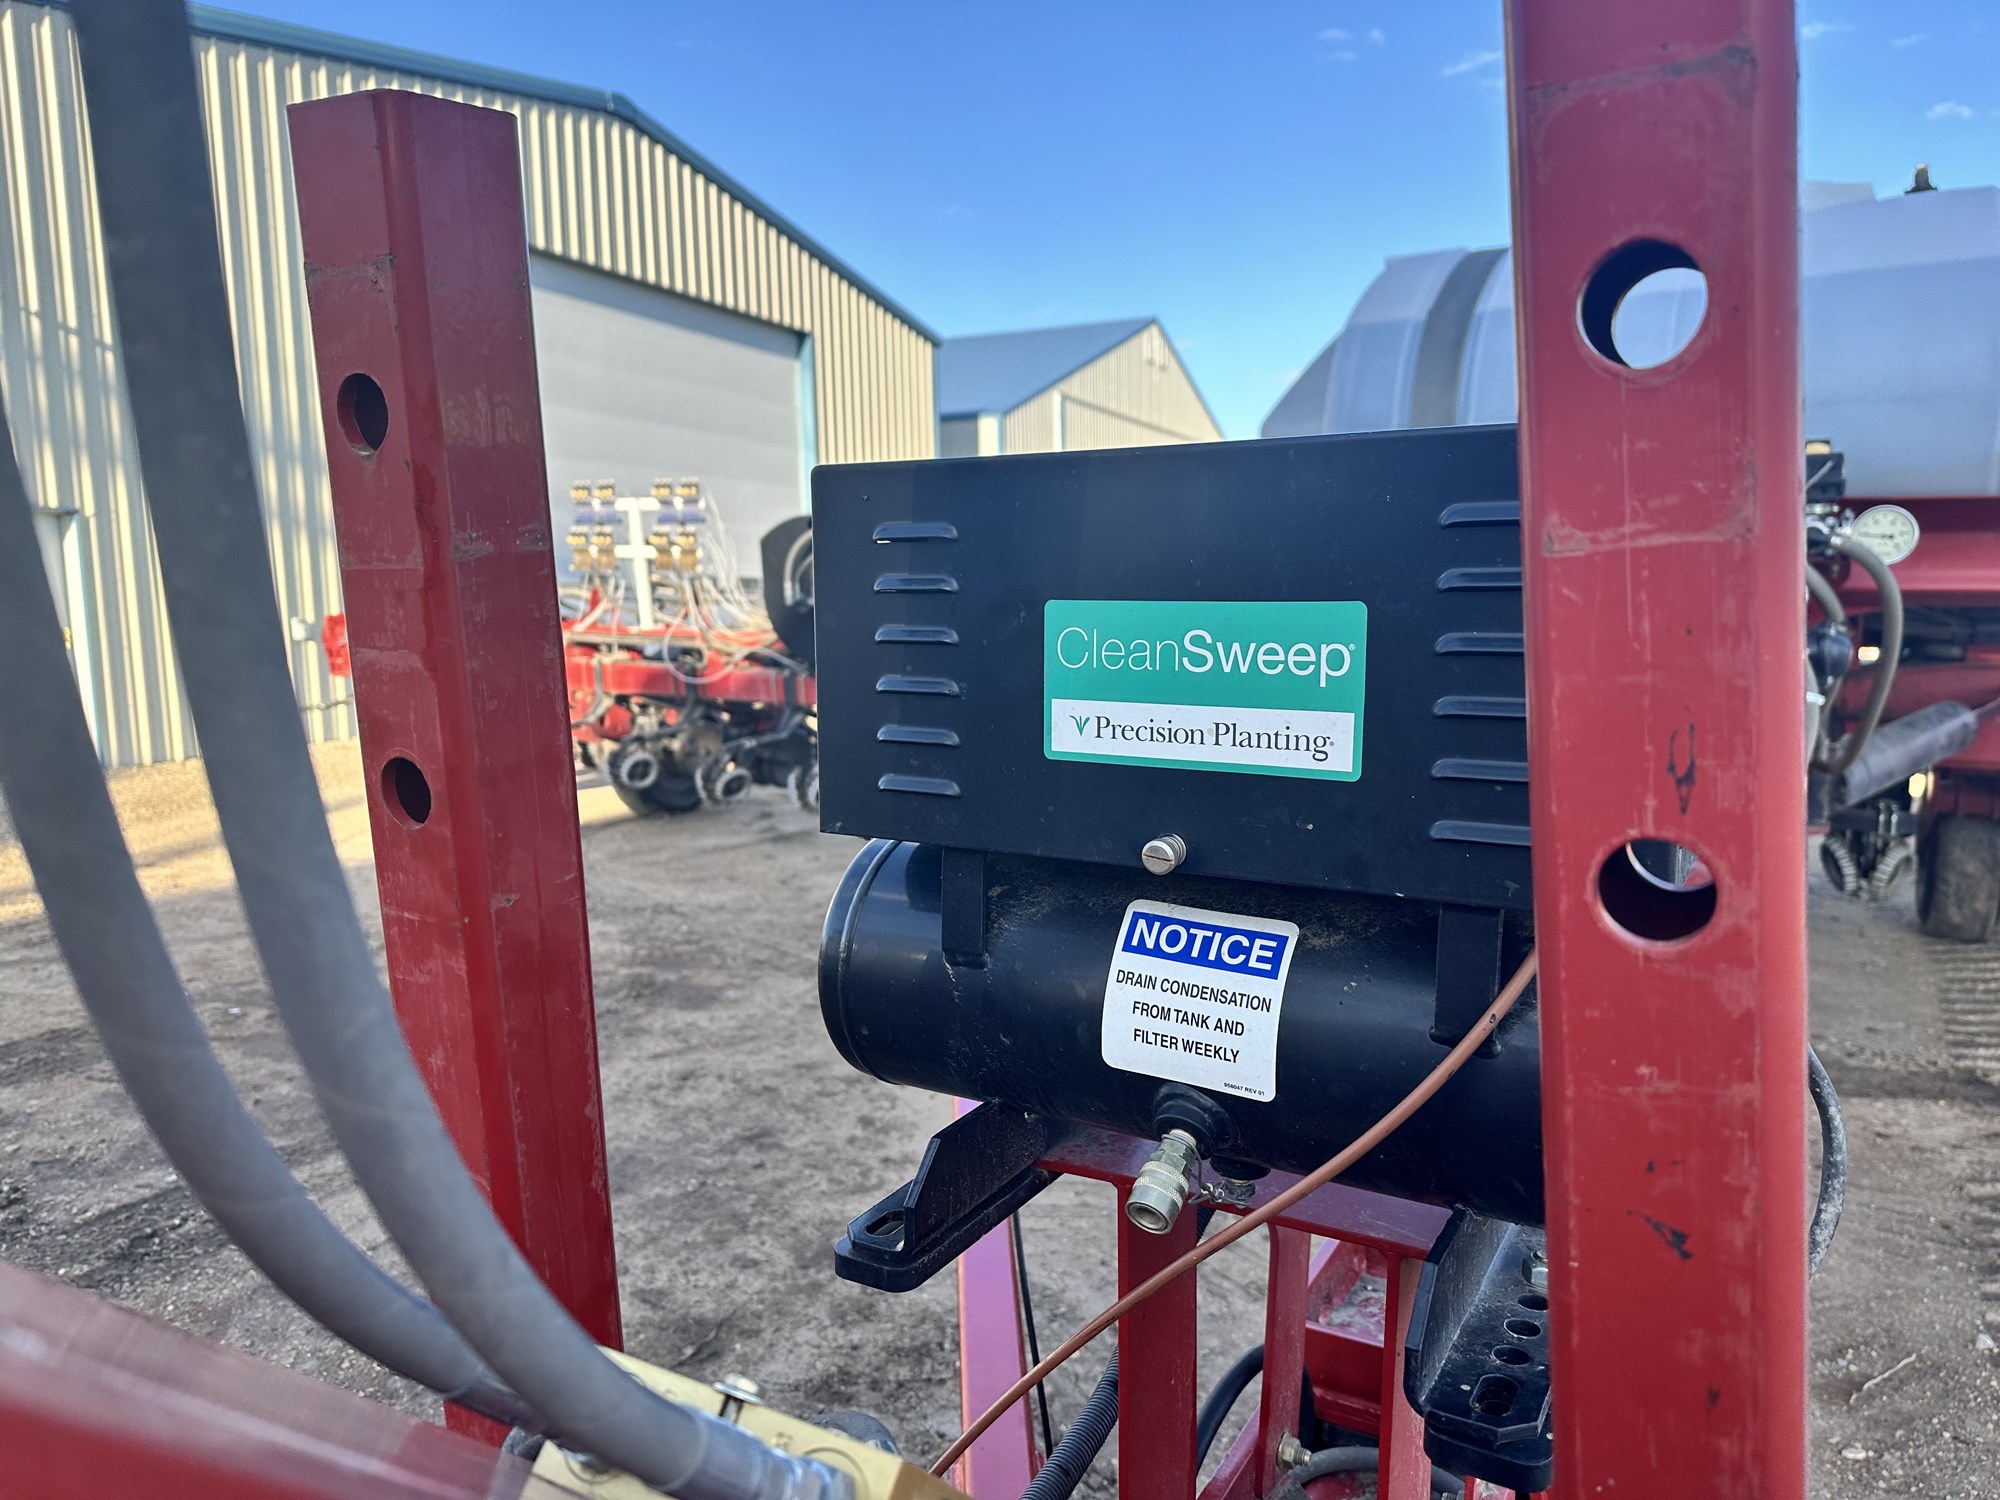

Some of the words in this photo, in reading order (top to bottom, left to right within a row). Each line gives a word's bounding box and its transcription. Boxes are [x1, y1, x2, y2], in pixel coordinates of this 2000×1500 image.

[1094, 715, 1206, 746] Precision
[1131, 918, 1278, 971] NOTICE
[1116, 969, 1158, 990] DRAIN
[1160, 978, 1272, 1013] CONDENSATION
[1132, 1001, 1171, 1022] FROM
[1174, 1009, 1211, 1030] TANK
[1214, 1018, 1245, 1037] AND
[1133, 1028, 1179, 1051] FILTER
[1182, 1038, 1240, 1064] WEEKLY
